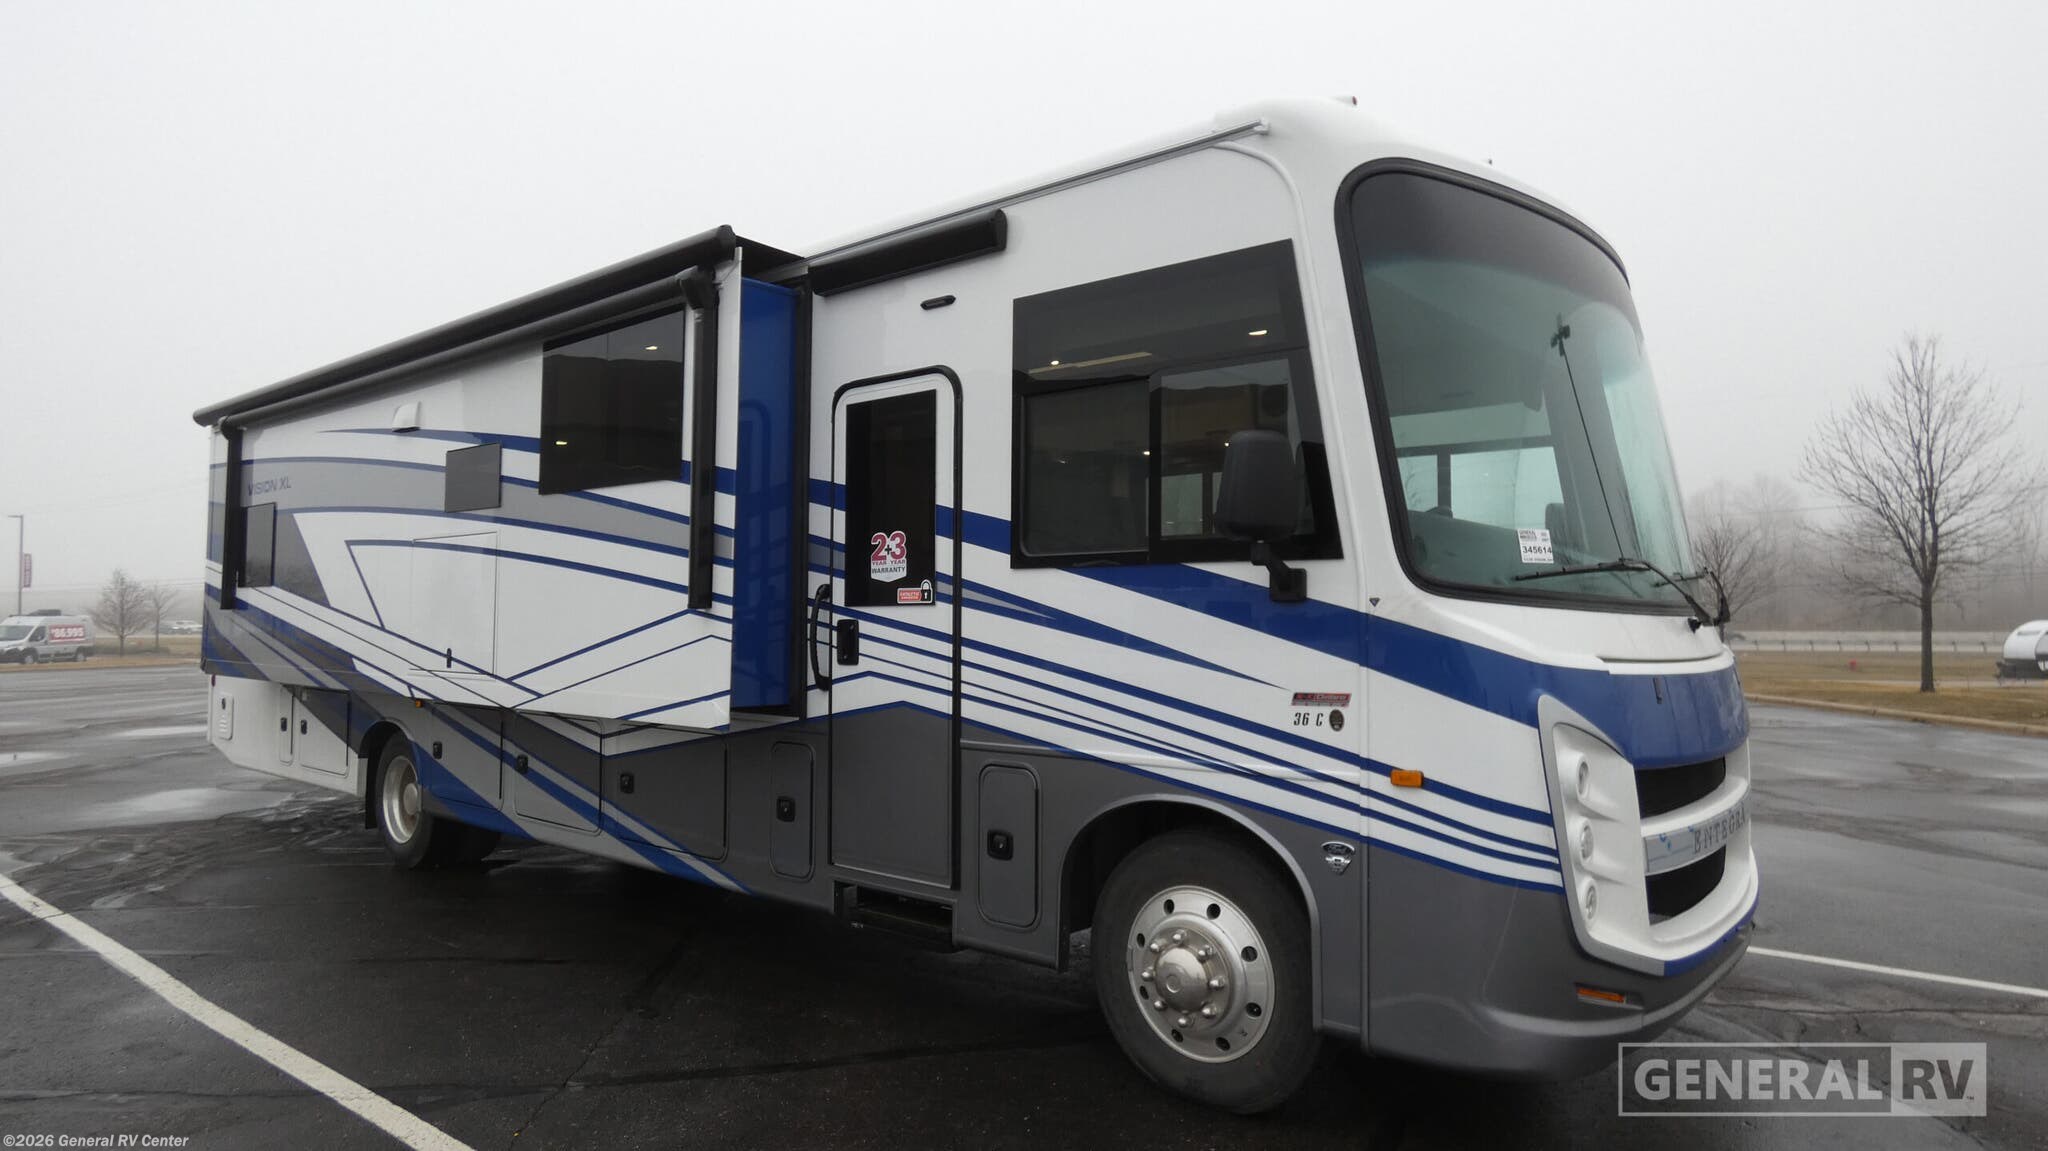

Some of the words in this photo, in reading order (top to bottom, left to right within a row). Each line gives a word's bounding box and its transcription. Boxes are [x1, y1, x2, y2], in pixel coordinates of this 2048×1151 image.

[248, 479, 278, 497] VISION
[279, 476, 292, 490] XL
[1522, 545, 1552, 554] 345614
[872, 566, 906, 574] WARRANTY
[1293, 712, 1310, 726] 36
[1315, 712, 1324, 727] C
